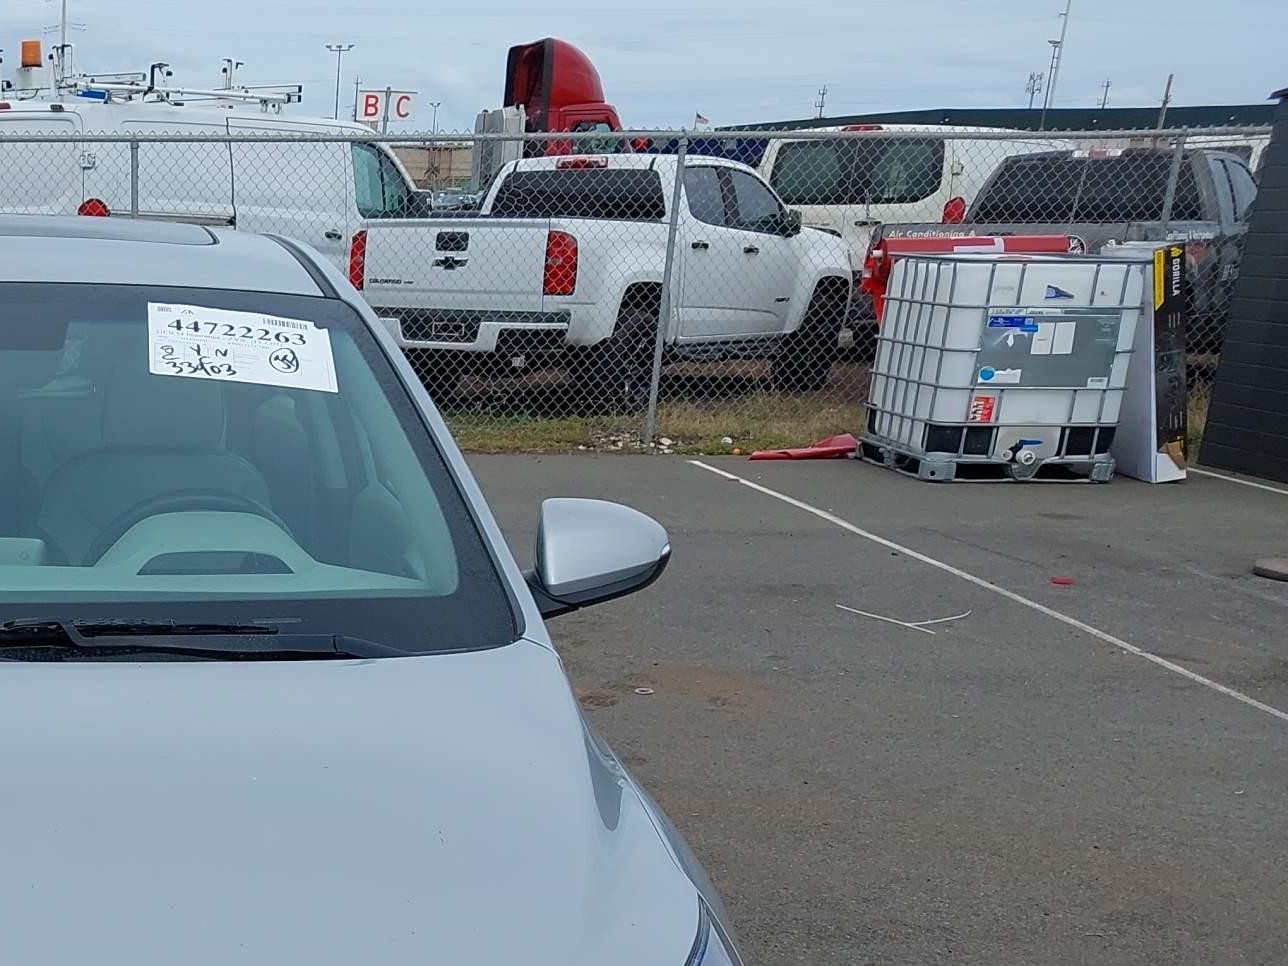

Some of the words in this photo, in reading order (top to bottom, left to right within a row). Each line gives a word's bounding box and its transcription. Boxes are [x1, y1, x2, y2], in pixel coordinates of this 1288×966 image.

[364, 94, 379, 117] B
[396, 95, 411, 118] C
[888, 230, 904, 238] Air
[1172, 257, 1181, 297] GORILLA
[167, 318, 308, 347] 44722263
